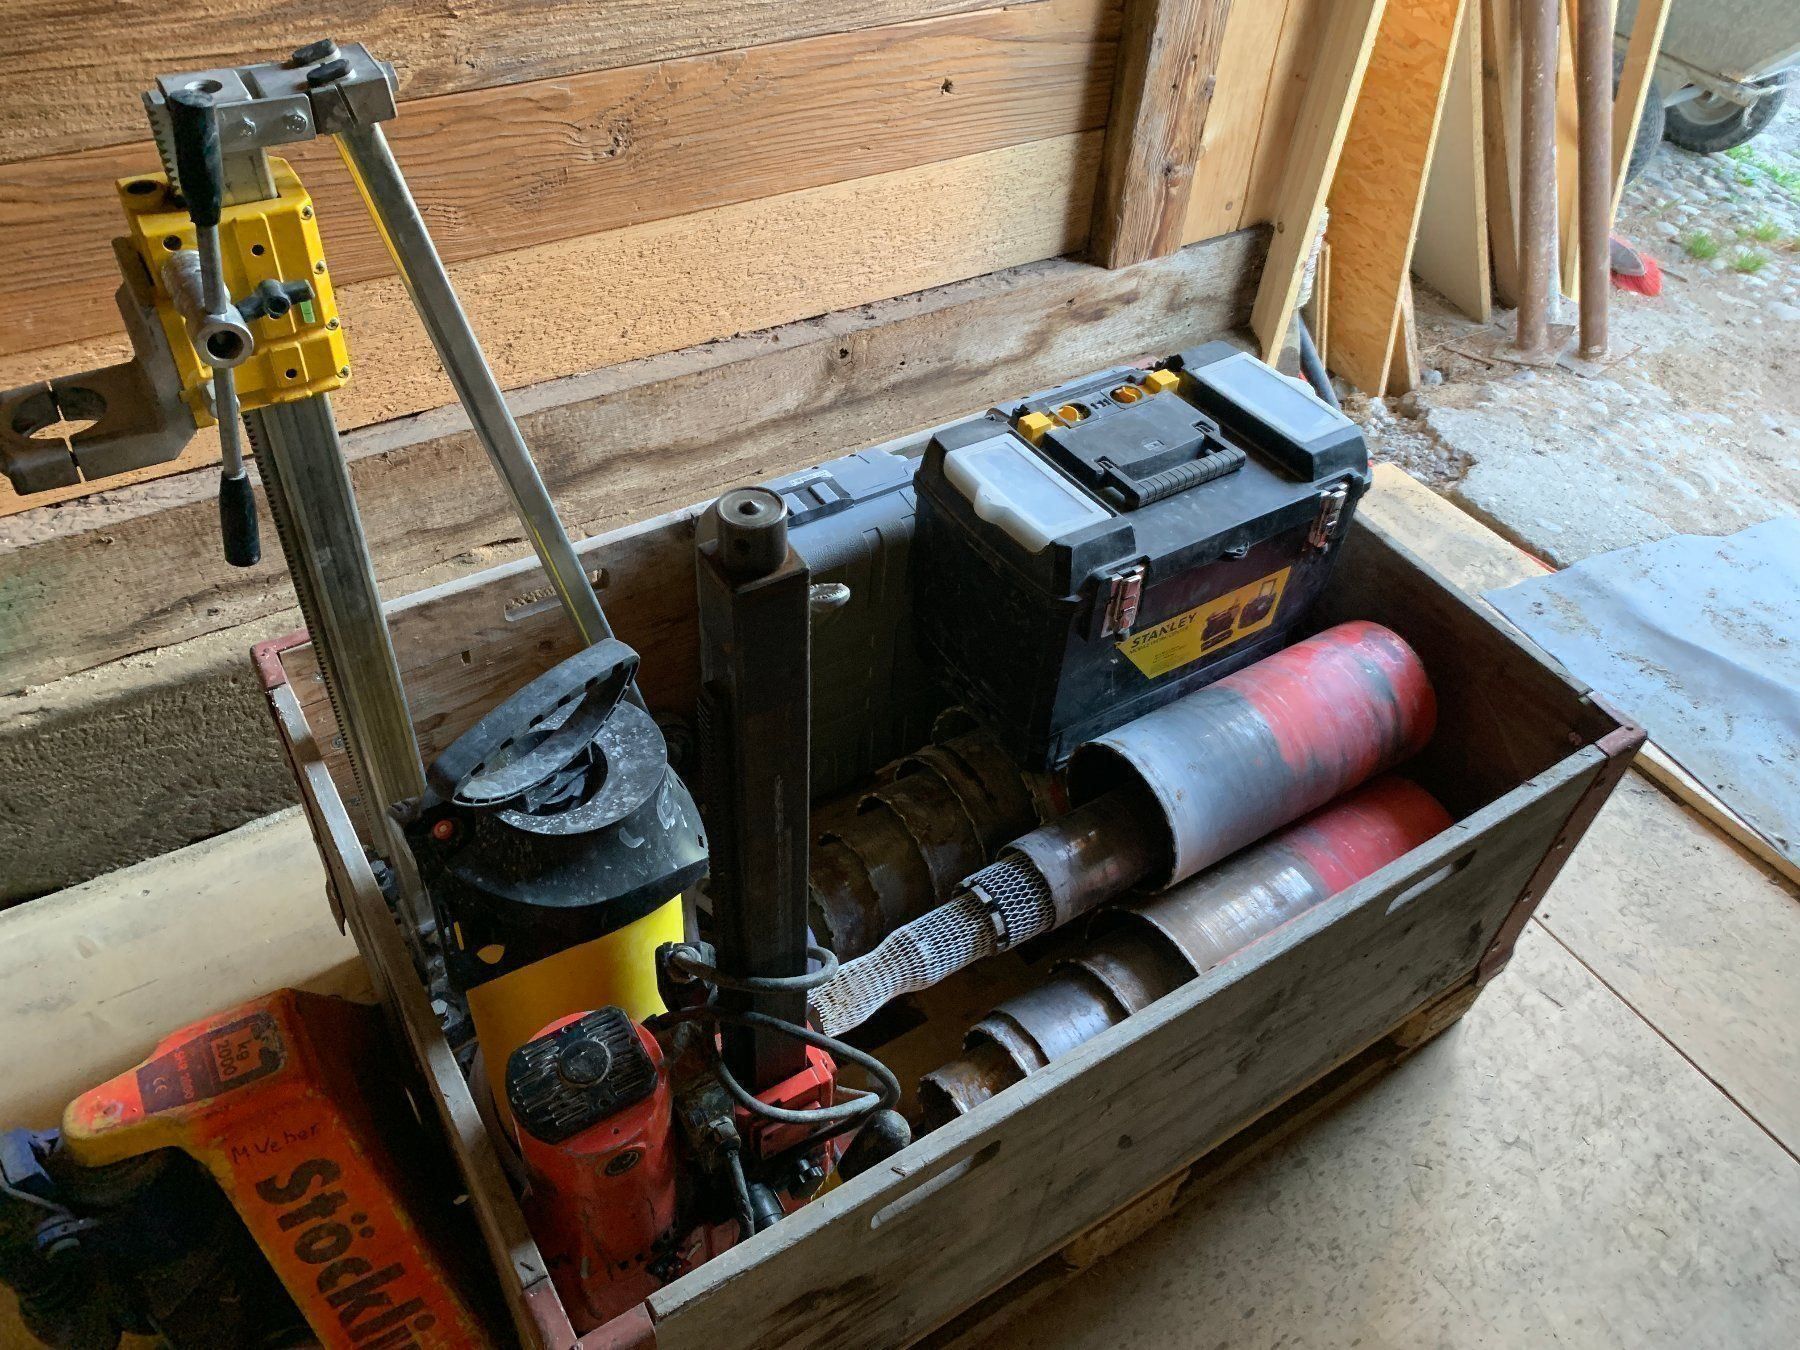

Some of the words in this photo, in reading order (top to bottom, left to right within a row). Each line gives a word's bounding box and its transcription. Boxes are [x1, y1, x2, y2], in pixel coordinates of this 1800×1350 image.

[1131, 613, 1197, 648] STANLEY
[216, 1039, 238, 1076] 2000
[236, 1042, 250, 1061] kg
[255, 1157, 437, 1350] Stöckli
